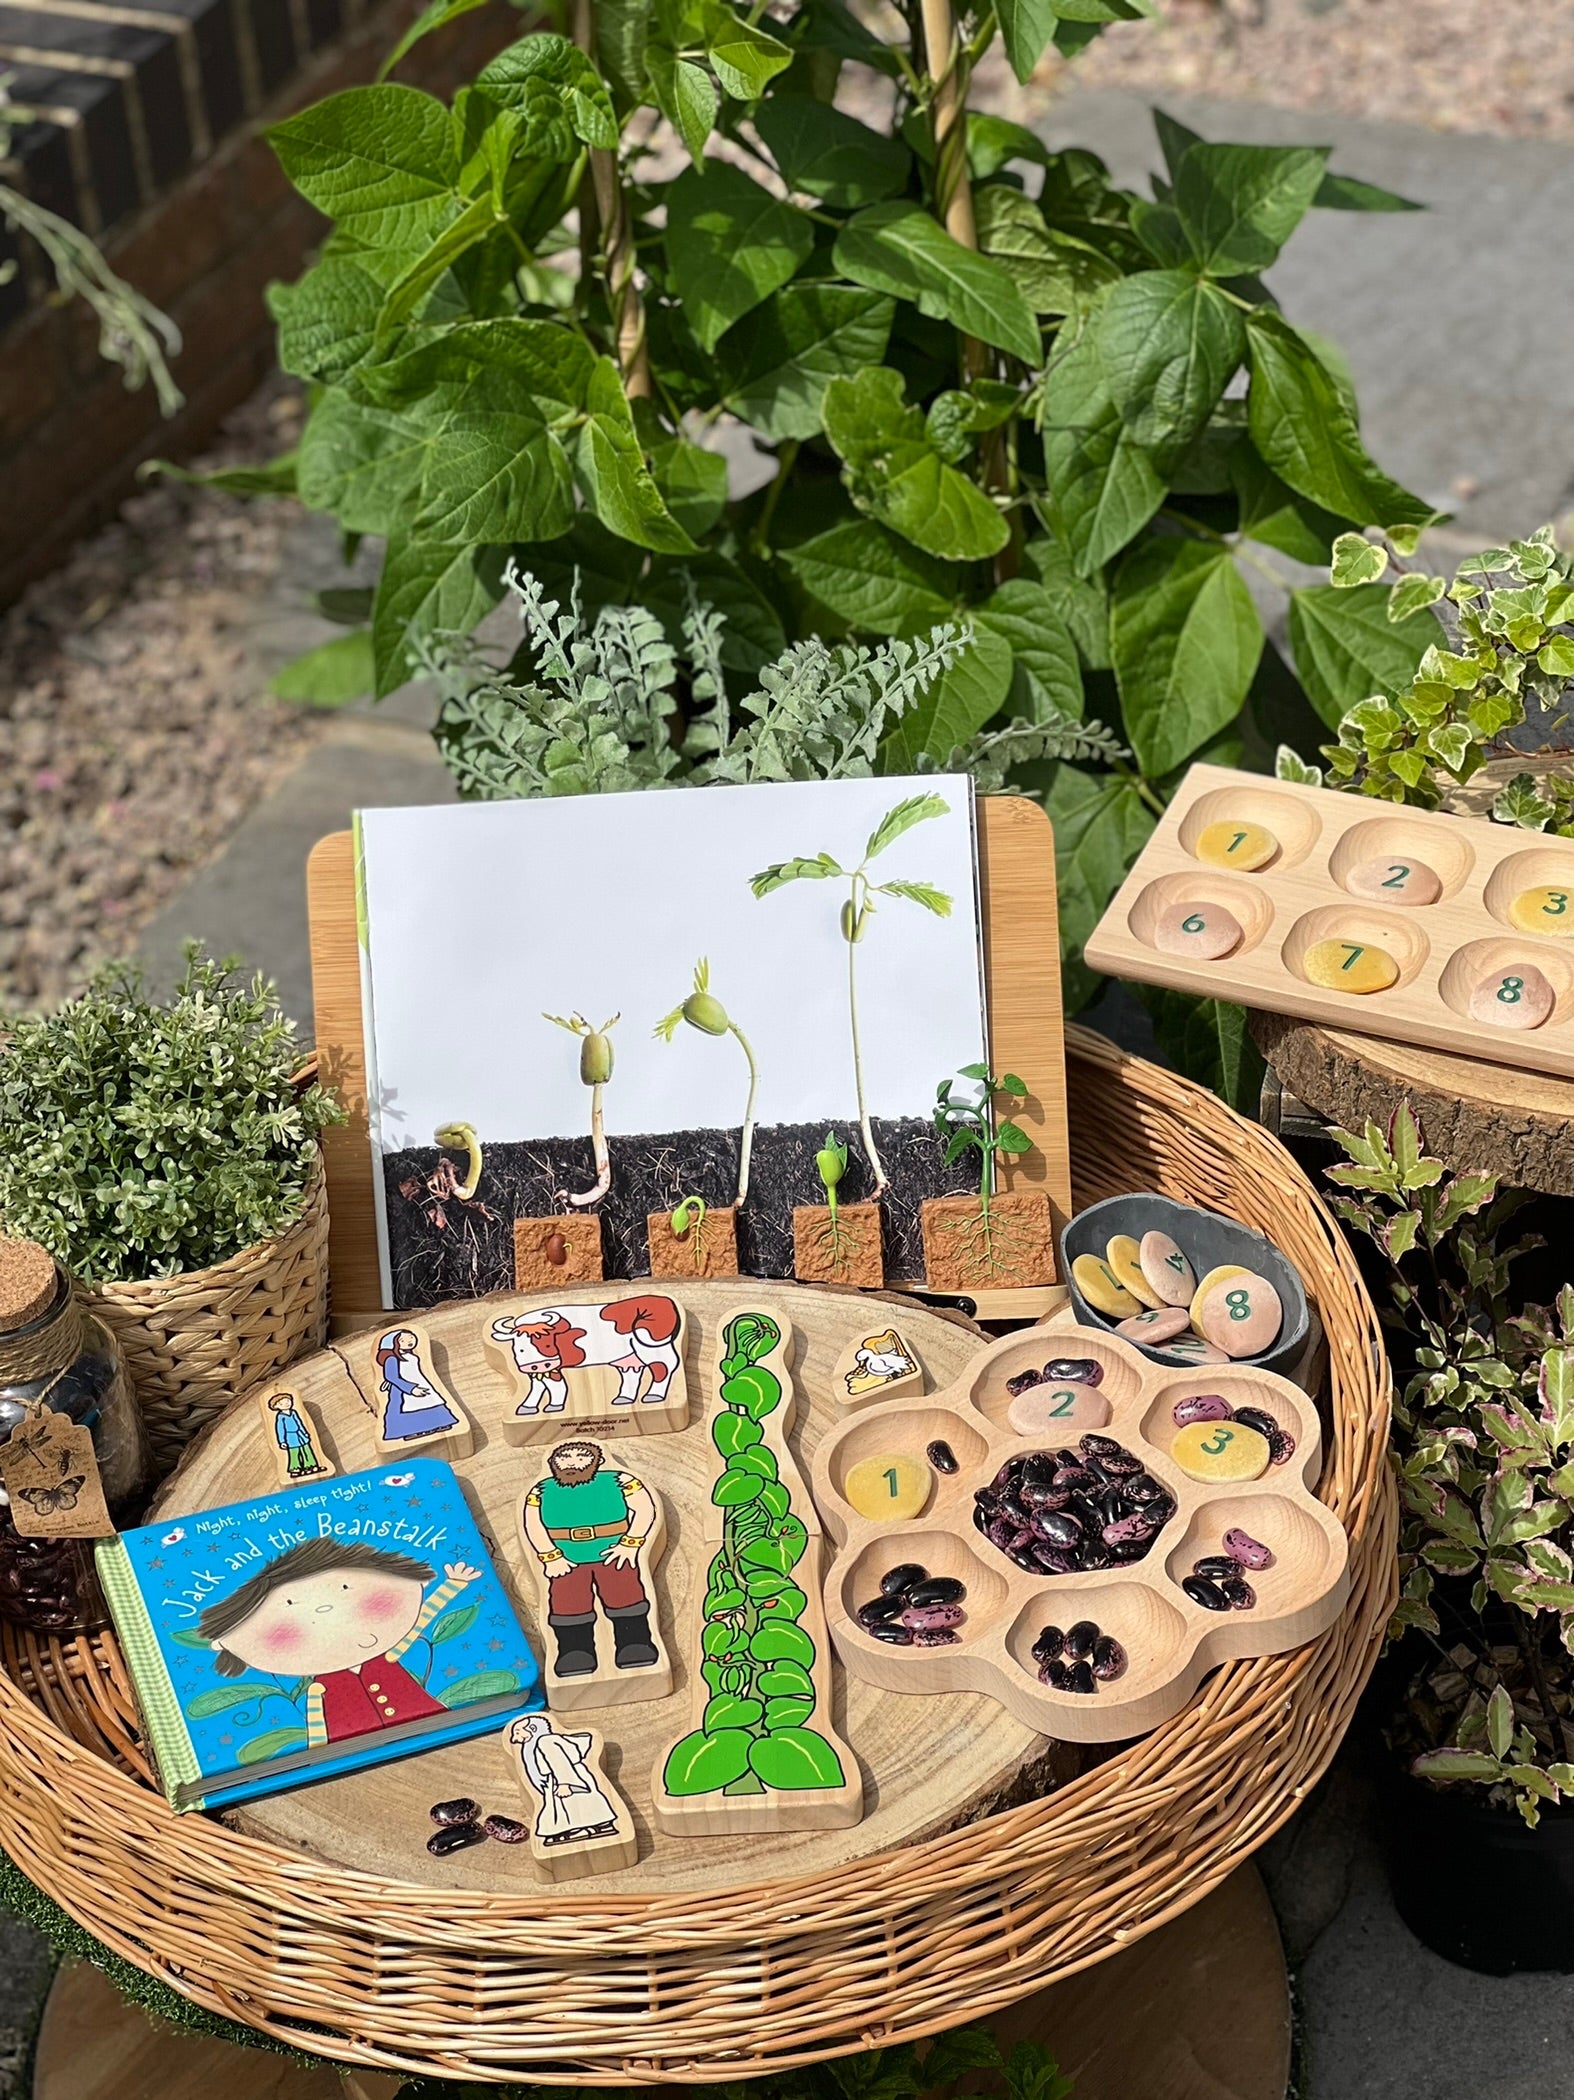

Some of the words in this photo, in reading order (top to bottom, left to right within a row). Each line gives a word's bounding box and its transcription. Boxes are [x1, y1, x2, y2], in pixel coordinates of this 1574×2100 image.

[1226, 831, 1247, 853] 1
[1381, 864, 1410, 889] 2
[1542, 892, 1569, 915] 3
[1181, 912, 1205, 934] 6
[1340, 943, 1365, 970] 7
[1496, 976, 1524, 1003] 8
[1225, 1289, 1251, 1321] 8
[1048, 1391, 1076, 1418] 2
[1200, 1428, 1235, 1455] 3
[882, 1468, 898, 1498] 1
[195, 1515, 241, 1535] Night,
[246, 1503, 289, 1523] night,
[294, 1494, 328, 1509] sleep
[331, 1480, 372, 1501] tight!
[161, 1569, 226, 1618] Jack
[224, 1537, 263, 1571] and
[268, 1528, 307, 1550] the
[317, 1512, 448, 1551] Beanstalk
